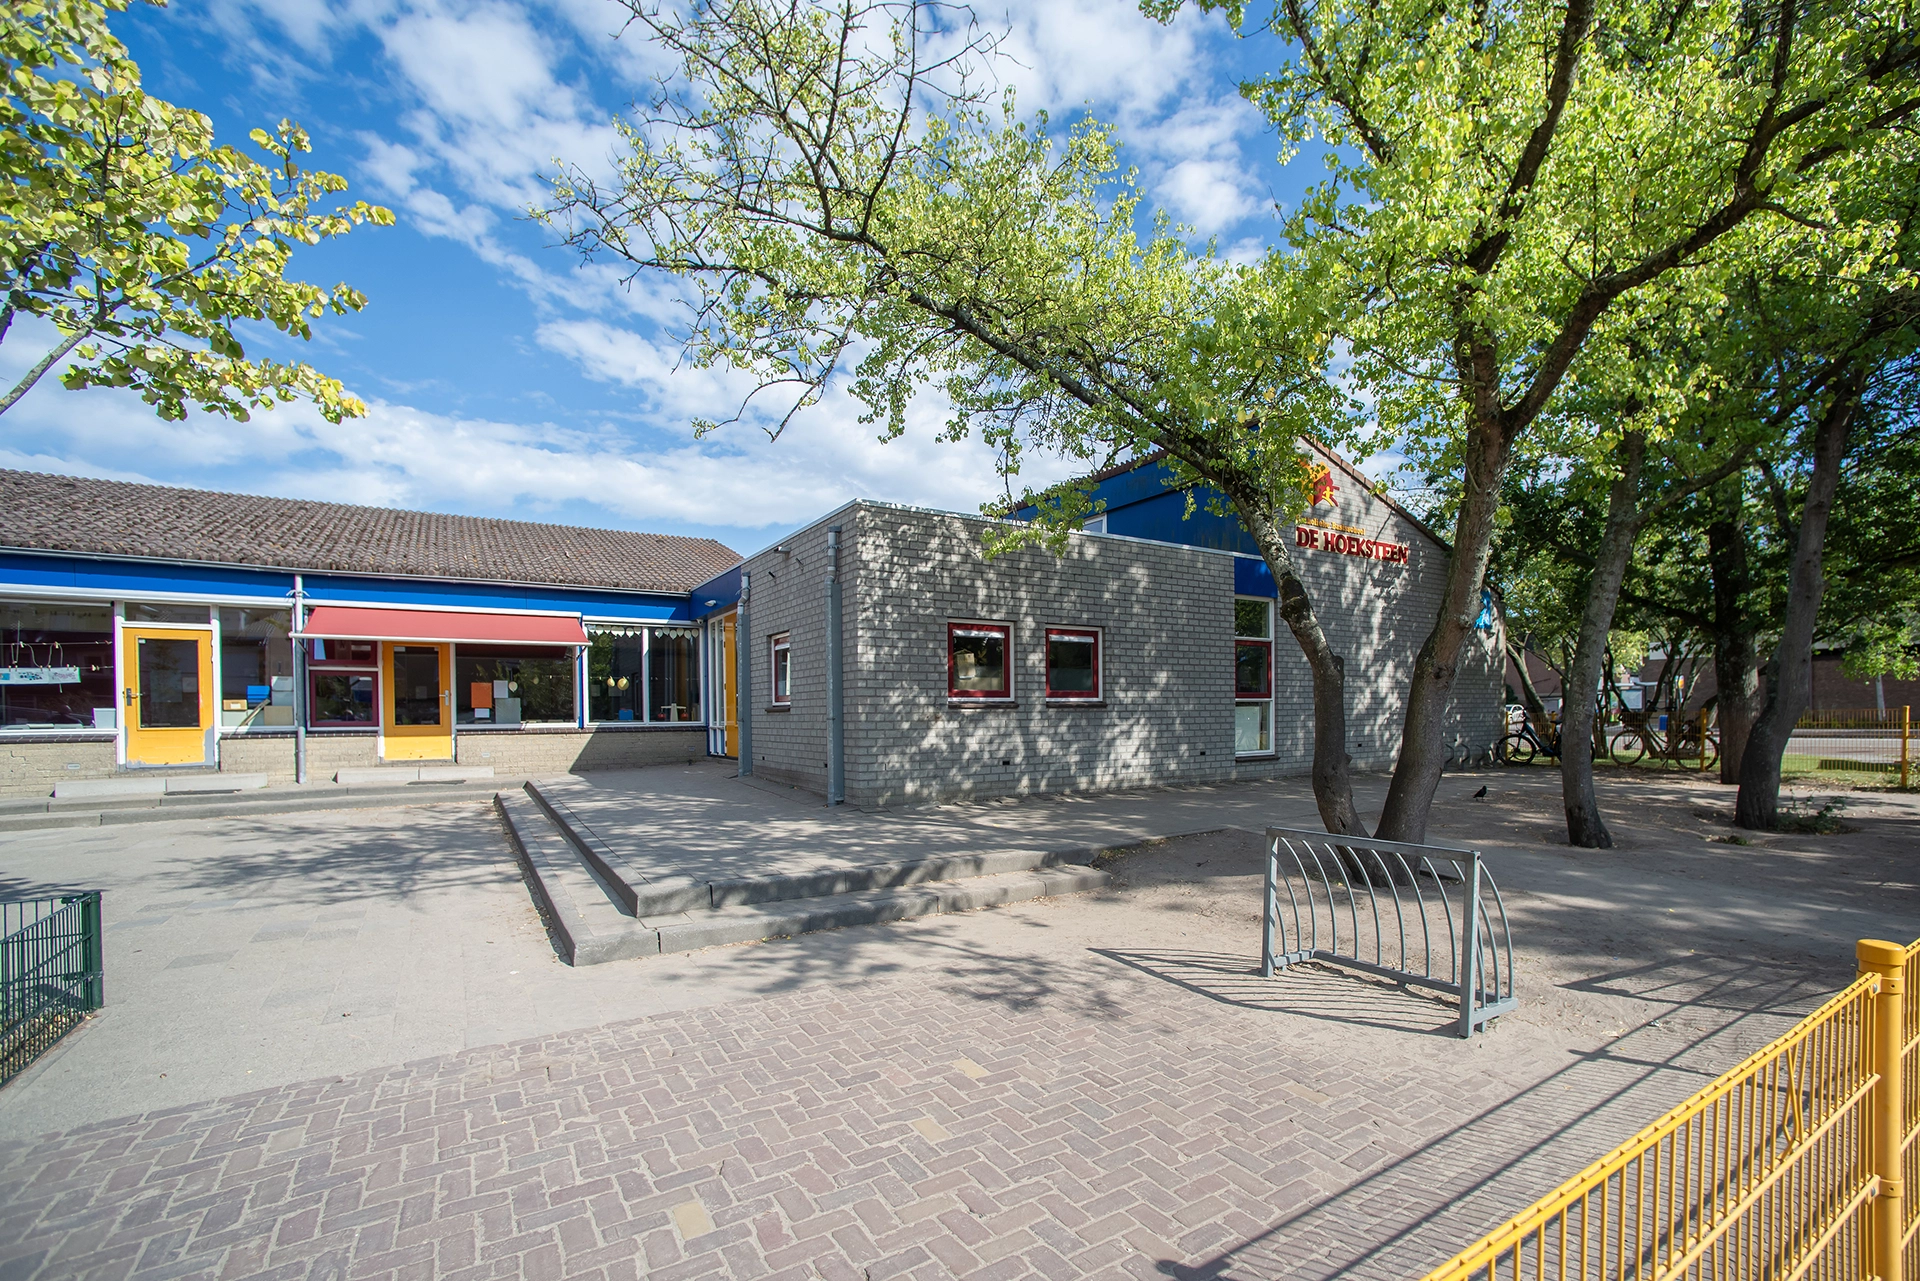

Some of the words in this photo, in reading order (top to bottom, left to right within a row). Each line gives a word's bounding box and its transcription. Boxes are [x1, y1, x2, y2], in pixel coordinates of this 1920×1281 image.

[1296, 516, 1330, 529] holieke
[1296, 526, 1319, 549] DE
[1323, 531, 1409, 564] HOEKSTEEN
